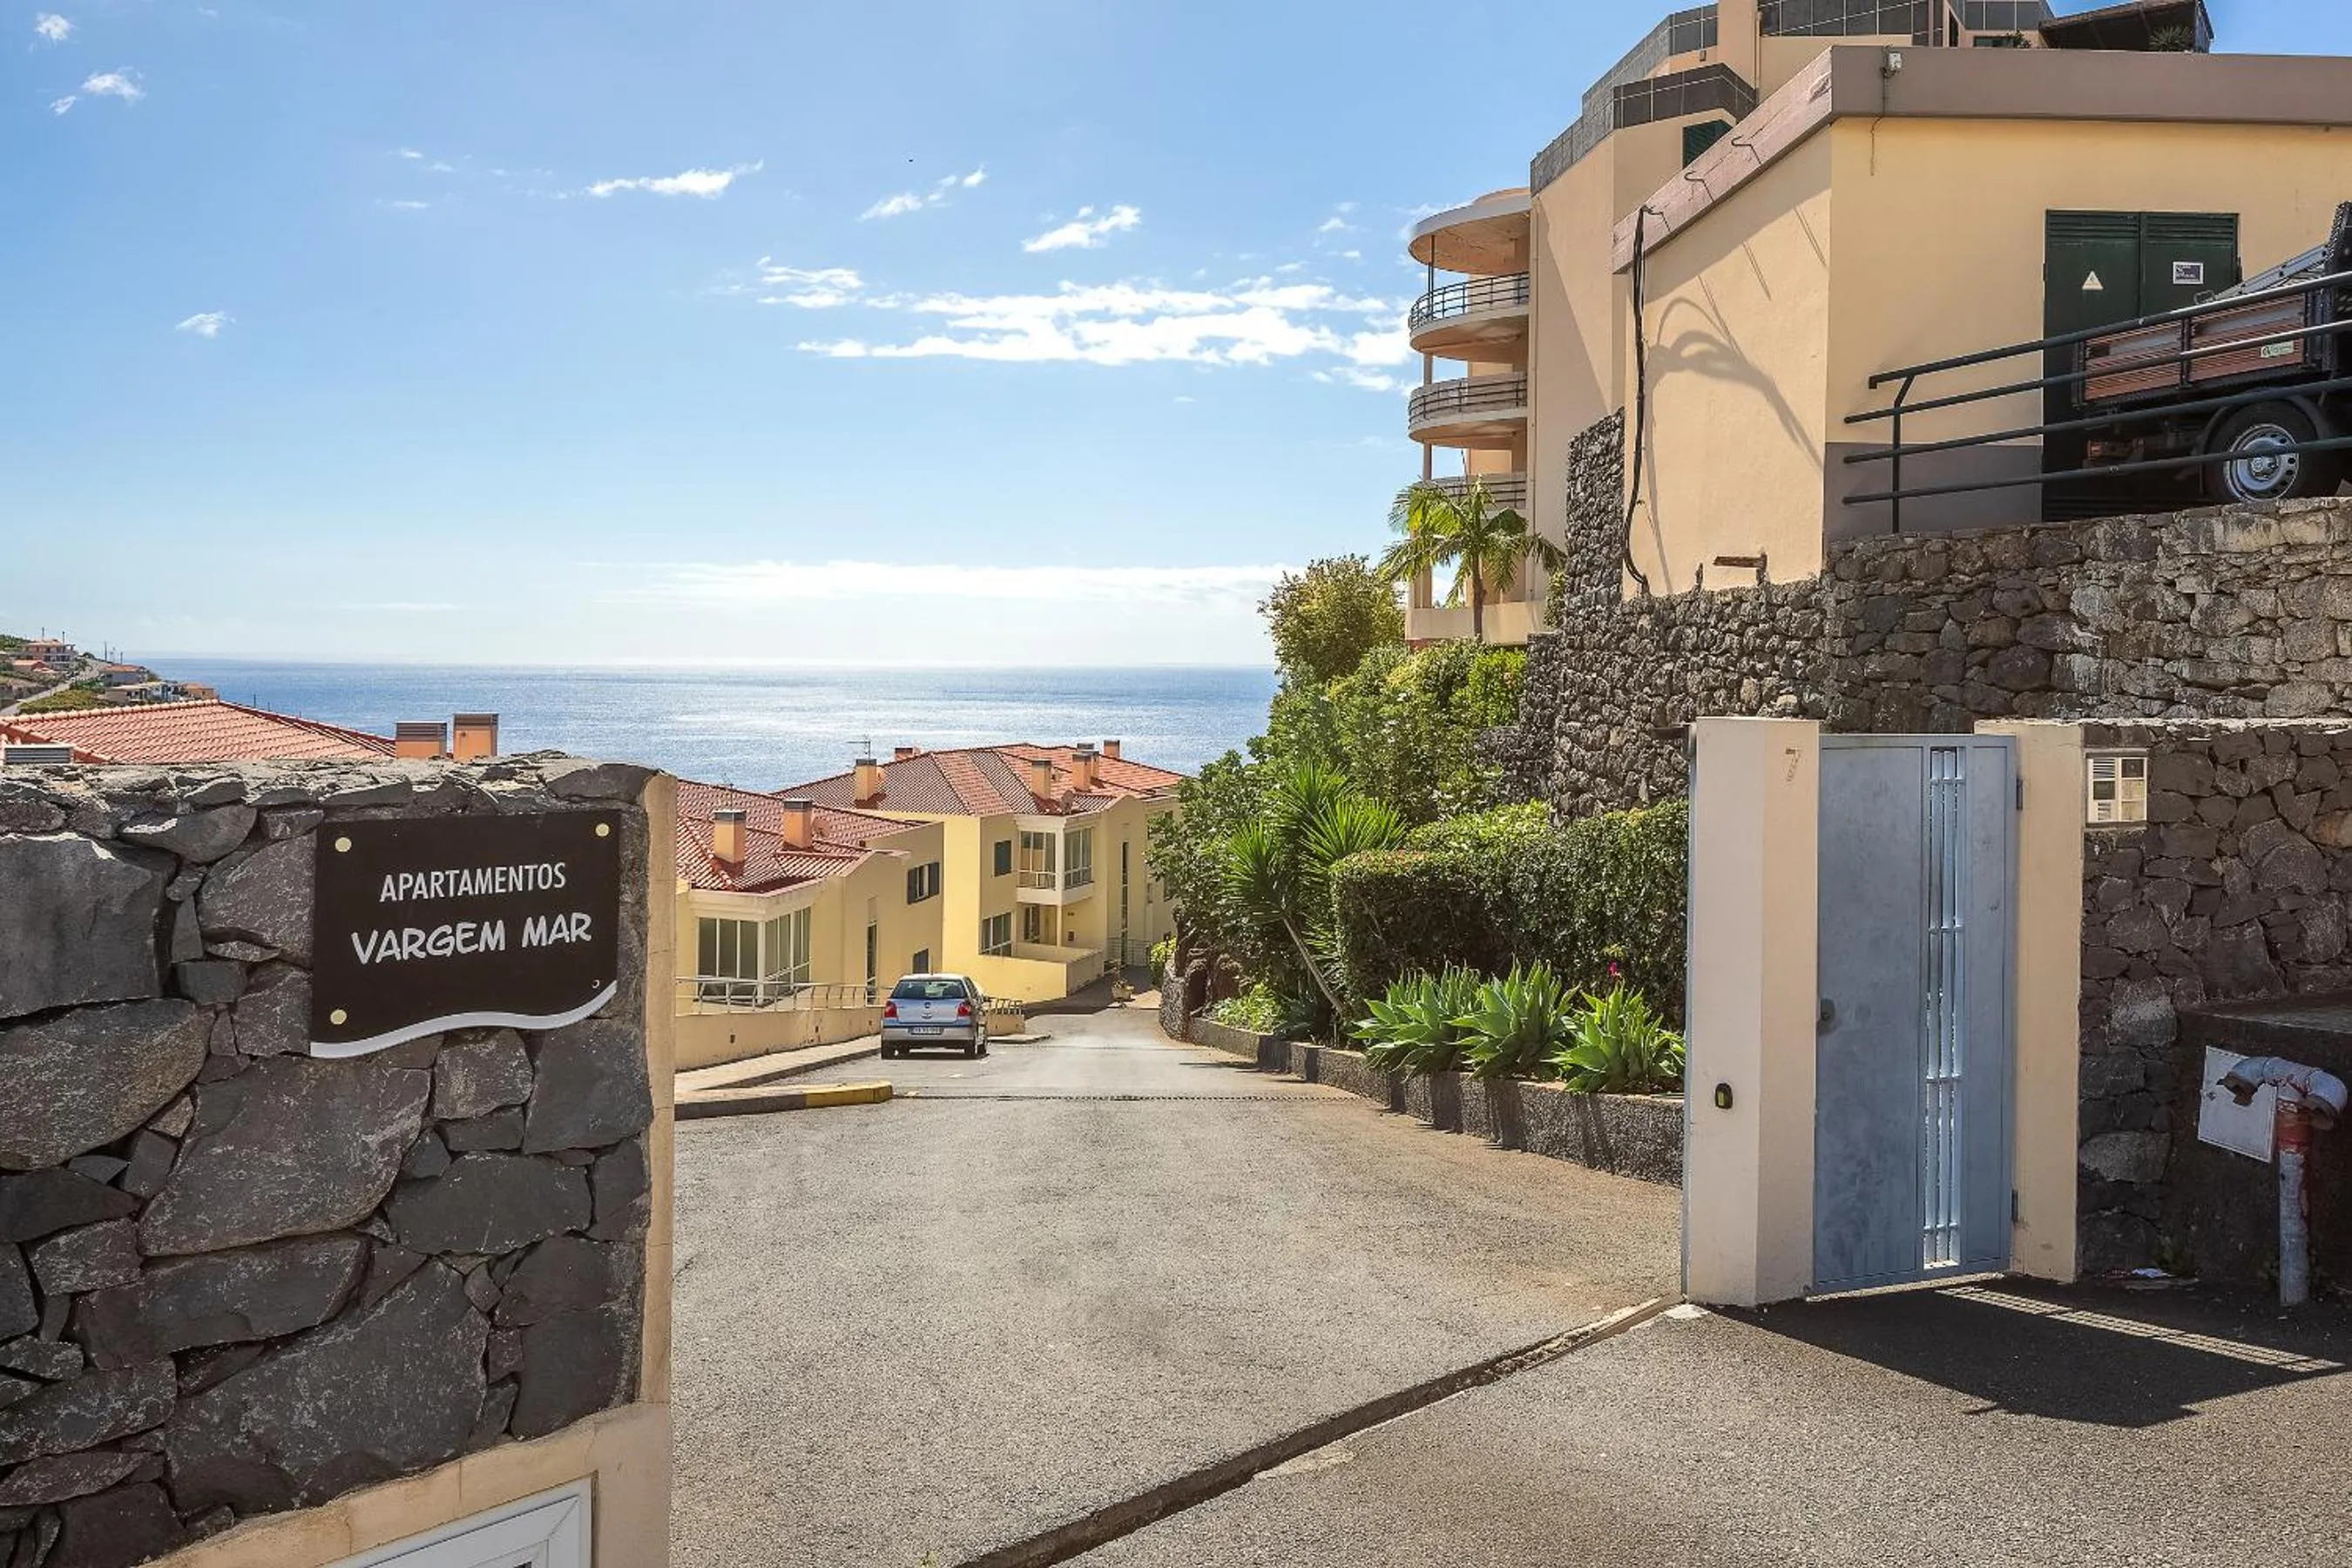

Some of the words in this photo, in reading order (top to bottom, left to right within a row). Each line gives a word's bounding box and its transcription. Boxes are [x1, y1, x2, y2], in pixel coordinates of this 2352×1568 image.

[1785, 747, 1802, 781] 7
[379, 862, 566, 902] APARTAMENTOS
[351, 919, 506, 965] VARGEM
[522, 912, 592, 948] MAR
